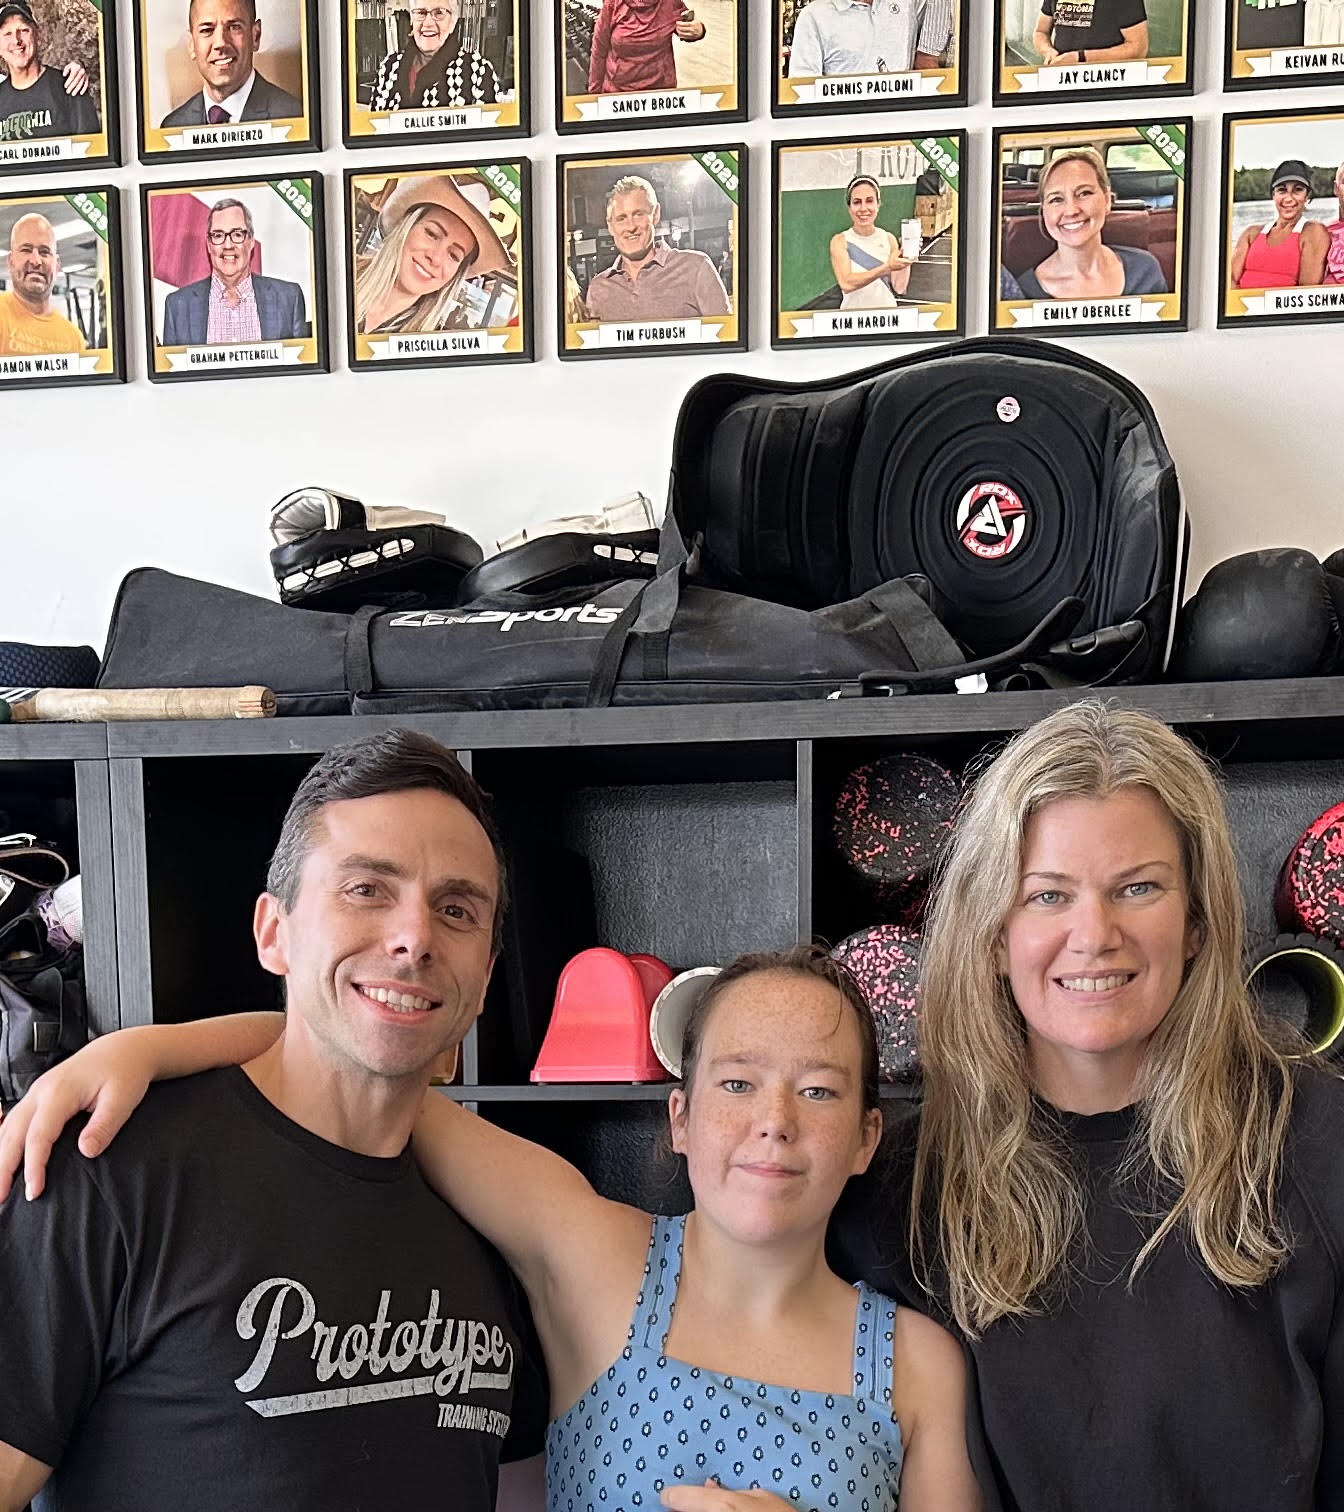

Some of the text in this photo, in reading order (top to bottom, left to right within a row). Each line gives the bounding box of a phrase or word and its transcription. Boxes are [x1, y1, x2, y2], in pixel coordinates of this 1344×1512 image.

[1284, 52, 1329, 70] KEIVAN
[1057, 67, 1127, 86] JAY CLANCY
[821, 77, 914, 98] DENNIS PAOLONI
[611, 94, 687, 114] SANDY BROCK
[403, 113, 468, 130] CALLIE SMITH
[191, 128, 264, 146] MARK DIRIENZO
[21, 144, 61, 160] DONADIO
[918, 137, 960, 178] 2025
[701, 150, 739, 192] 2025
[1274, 293, 1305, 310] RUSS
[1042, 303, 1132, 322] EMILY OBERLEE
[830, 314, 900, 331] KIM HARDIN
[615, 325, 687, 343] TIM FURBUSH
[396, 335, 482, 354] PRISCILLA SILVA
[33, 357, 69, 373] WALSH
[189, 348, 280, 365] GRAHAM PETTENGILL
[234, 1277, 513, 1396] Prototype
[437, 1403, 488, 1431] TRAINING
